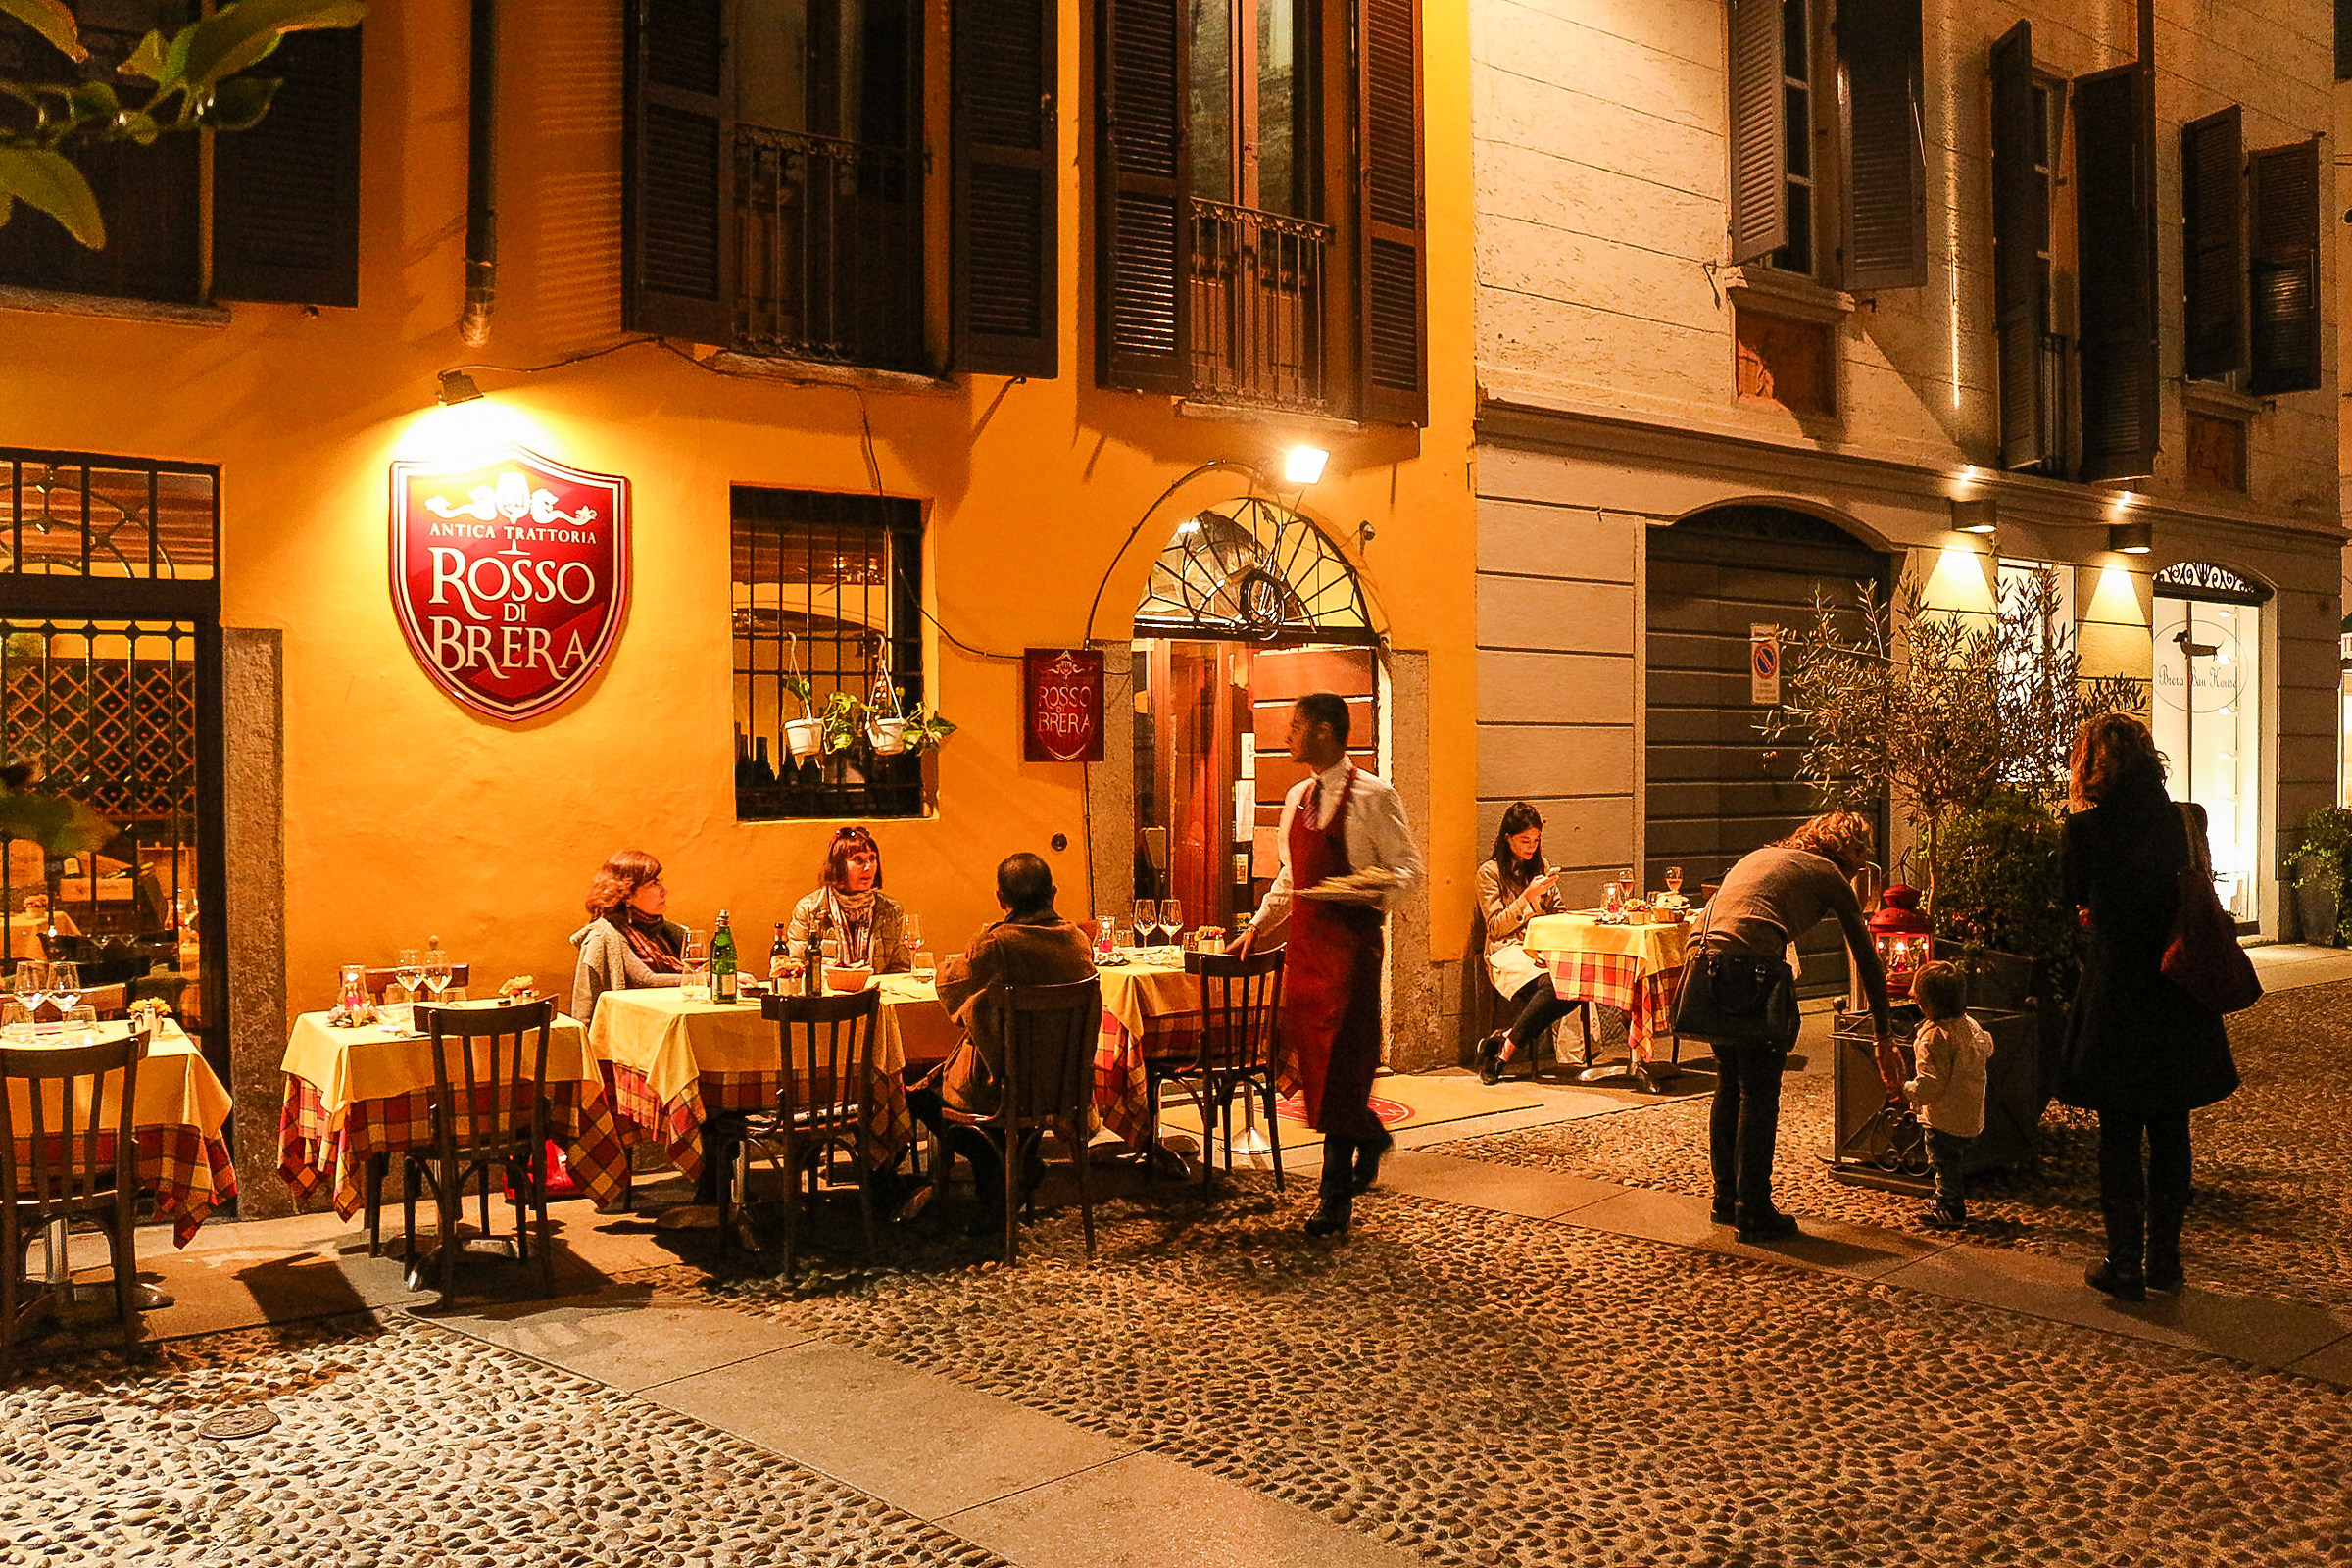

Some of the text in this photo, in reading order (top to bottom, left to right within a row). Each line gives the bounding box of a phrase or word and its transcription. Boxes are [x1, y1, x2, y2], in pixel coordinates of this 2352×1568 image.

[429, 523, 597, 544] ANTICA TRATTORIA
[428, 547, 596, 620] ROSSO
[503, 603, 527, 622] DI
[428, 615, 590, 680] BRERA
[1039, 686, 1092, 709] ROSSO
[1038, 711, 1091, 737] BRERA
